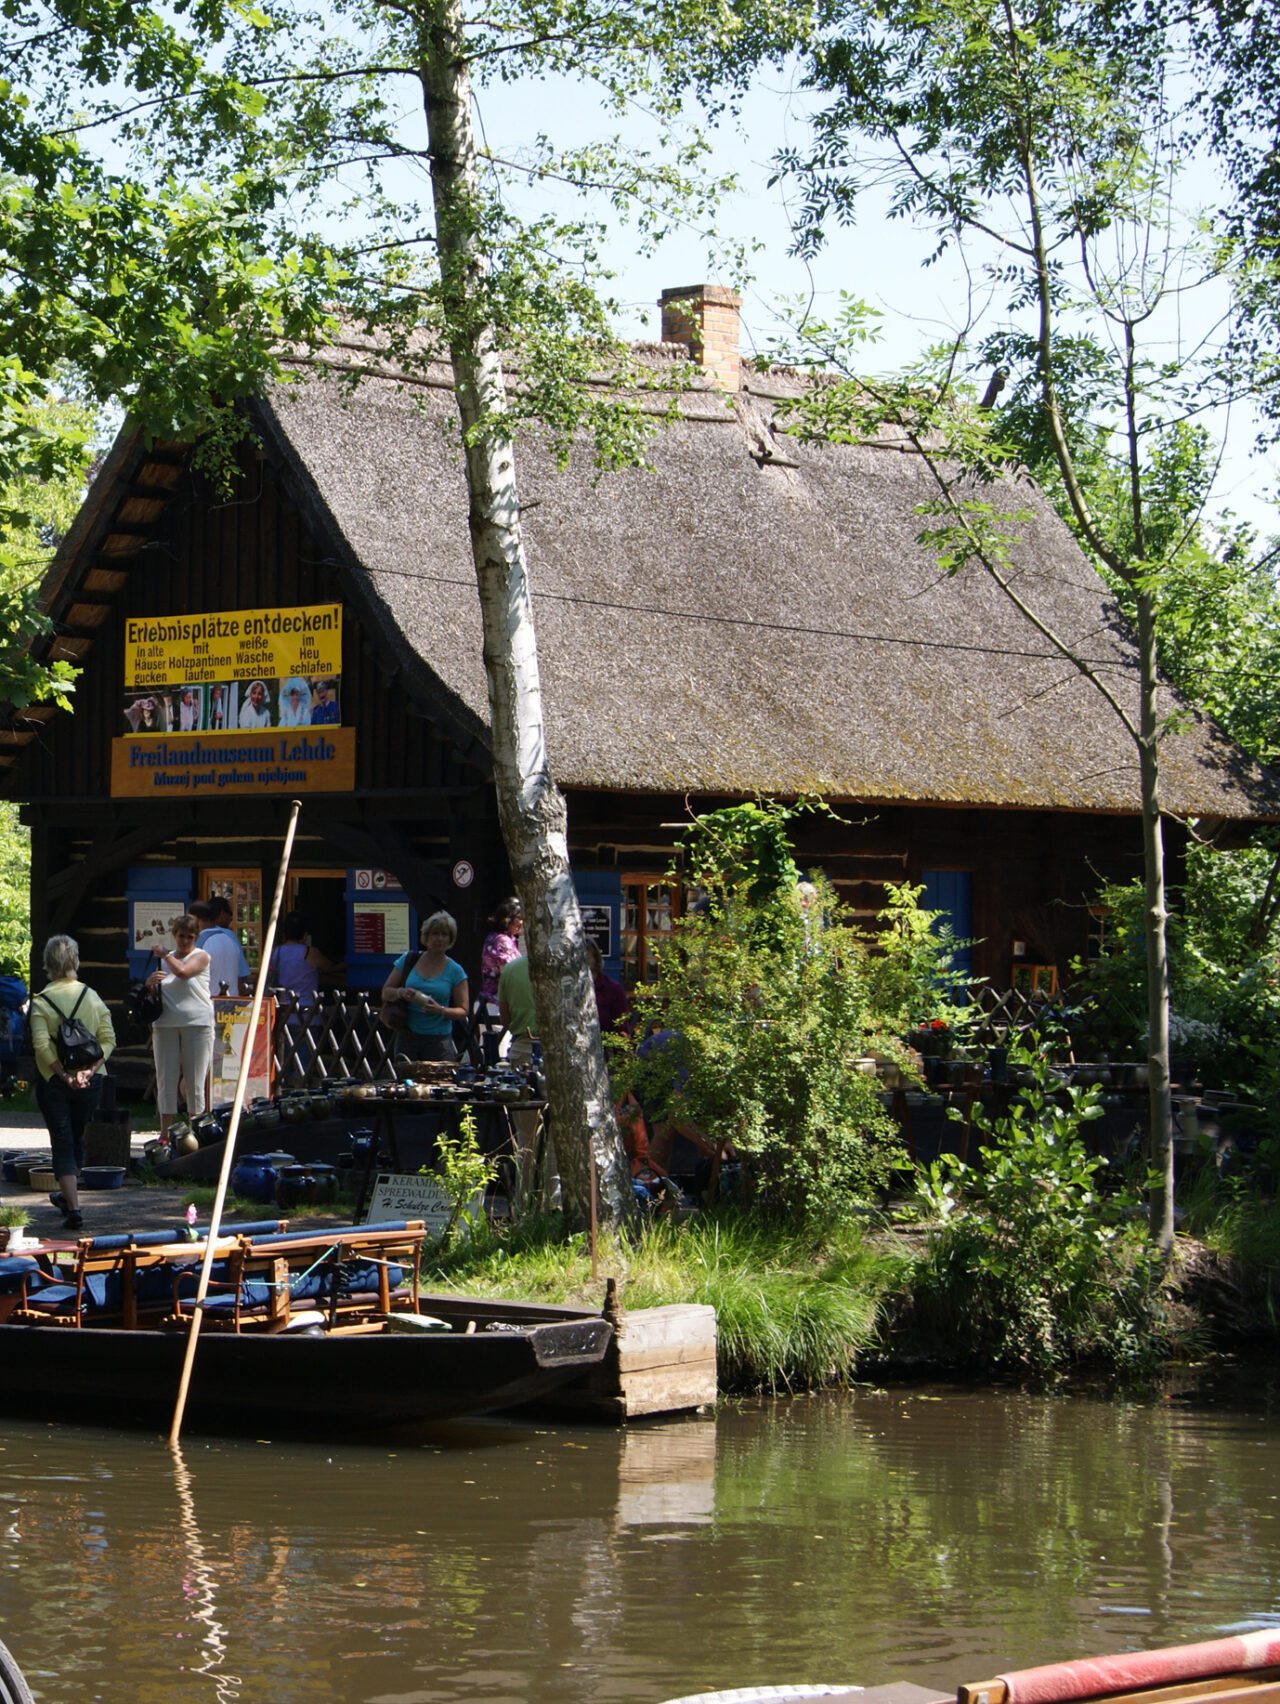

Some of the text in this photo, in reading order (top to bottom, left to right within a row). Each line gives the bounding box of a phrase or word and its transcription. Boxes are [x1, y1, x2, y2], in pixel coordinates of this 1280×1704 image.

[128, 607, 339, 644] Erlebnisplätze entdecken!
[239, 636, 269, 650] weiße
[302, 634, 315, 647] im
[136, 644, 165, 658] in alte
[193, 642, 210, 655] mit
[299, 647, 320, 660] Heu
[134, 658, 167, 671] Häuser
[168, 655, 232, 670] Holzpantinen
[236, 650, 274, 665] Wäsche
[184, 668, 216, 682] laufen
[233, 664, 276, 678] waschen
[289, 661, 333, 675] schlafen
[134, 671, 168, 685] gucken
[129, 737, 335, 768] Freilandmuseum Lehde
[153, 772, 190, 788] Muzej
[192, 770, 215, 789] pod
